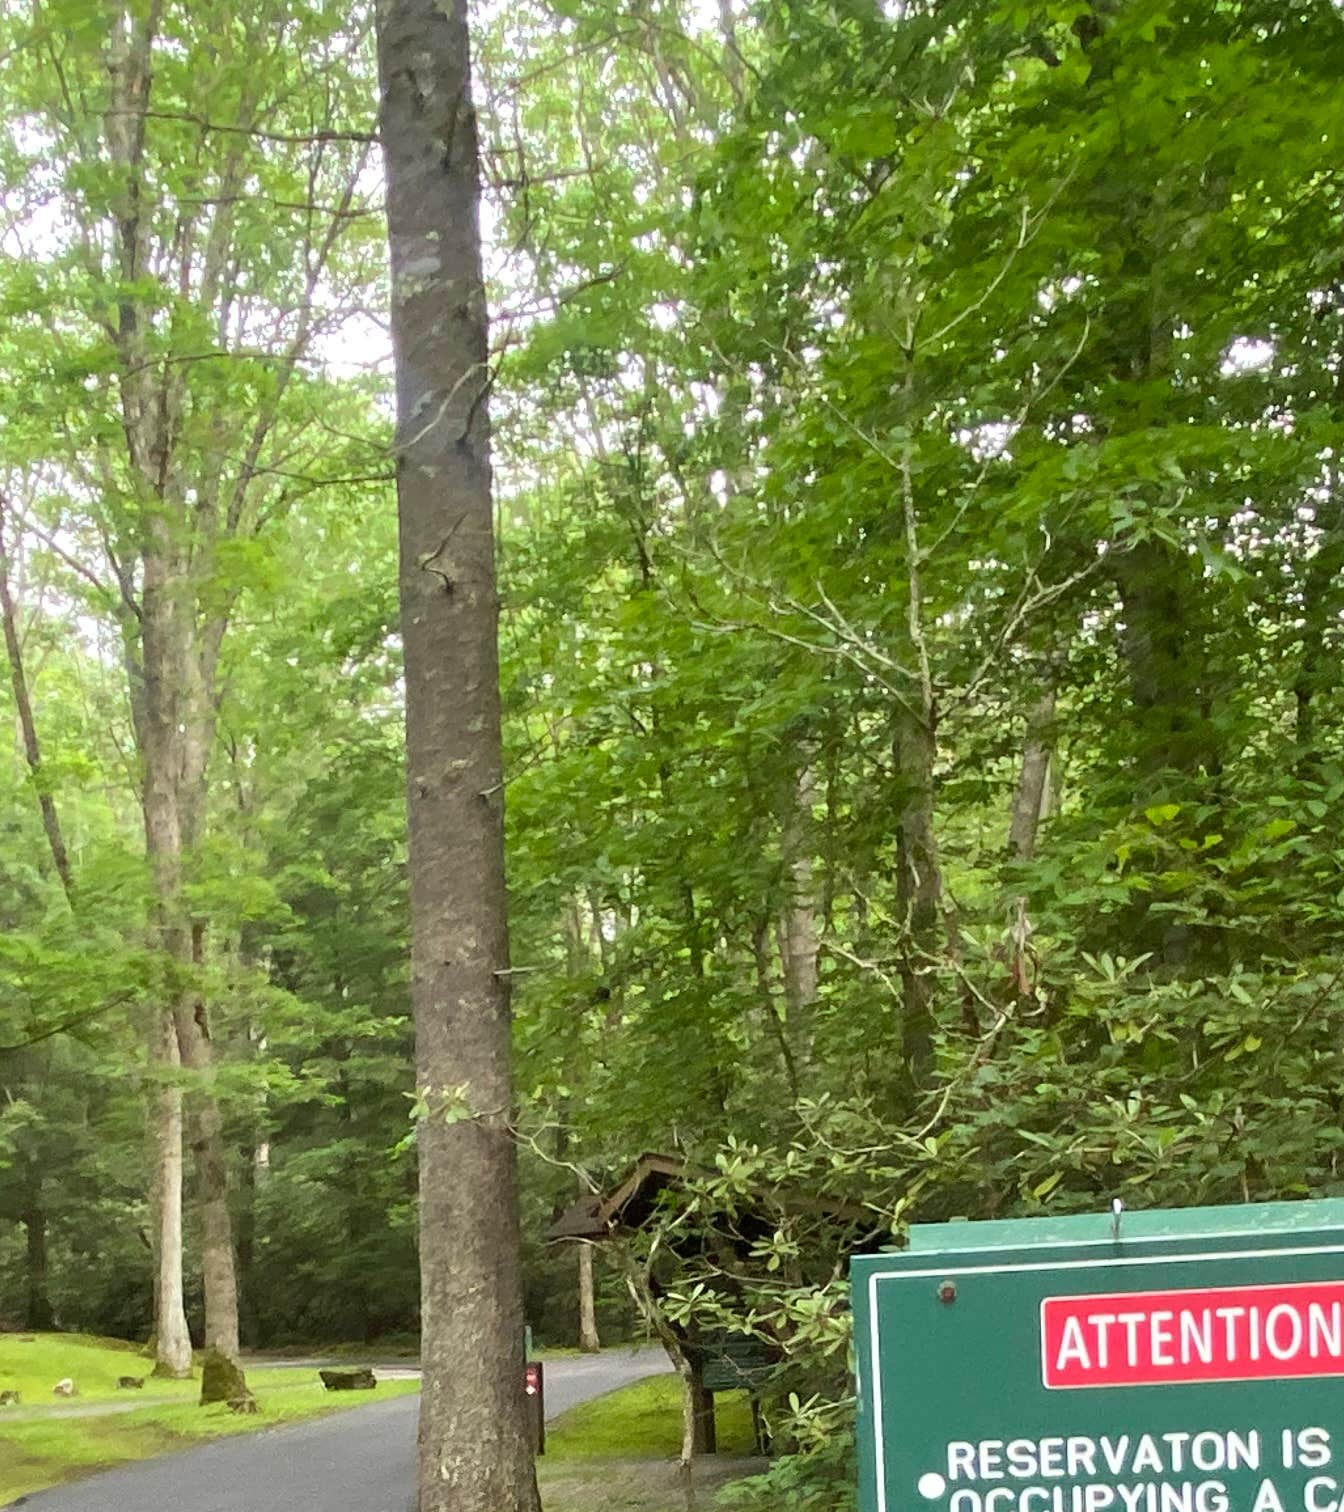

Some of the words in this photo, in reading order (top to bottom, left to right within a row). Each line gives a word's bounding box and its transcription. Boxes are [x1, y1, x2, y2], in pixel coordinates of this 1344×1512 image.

[1056, 1301, 1342, 1371] ATTENTION
[947, 1429, 1260, 1481] RESERVATON
[1282, 1427, 1332, 1469] IS
